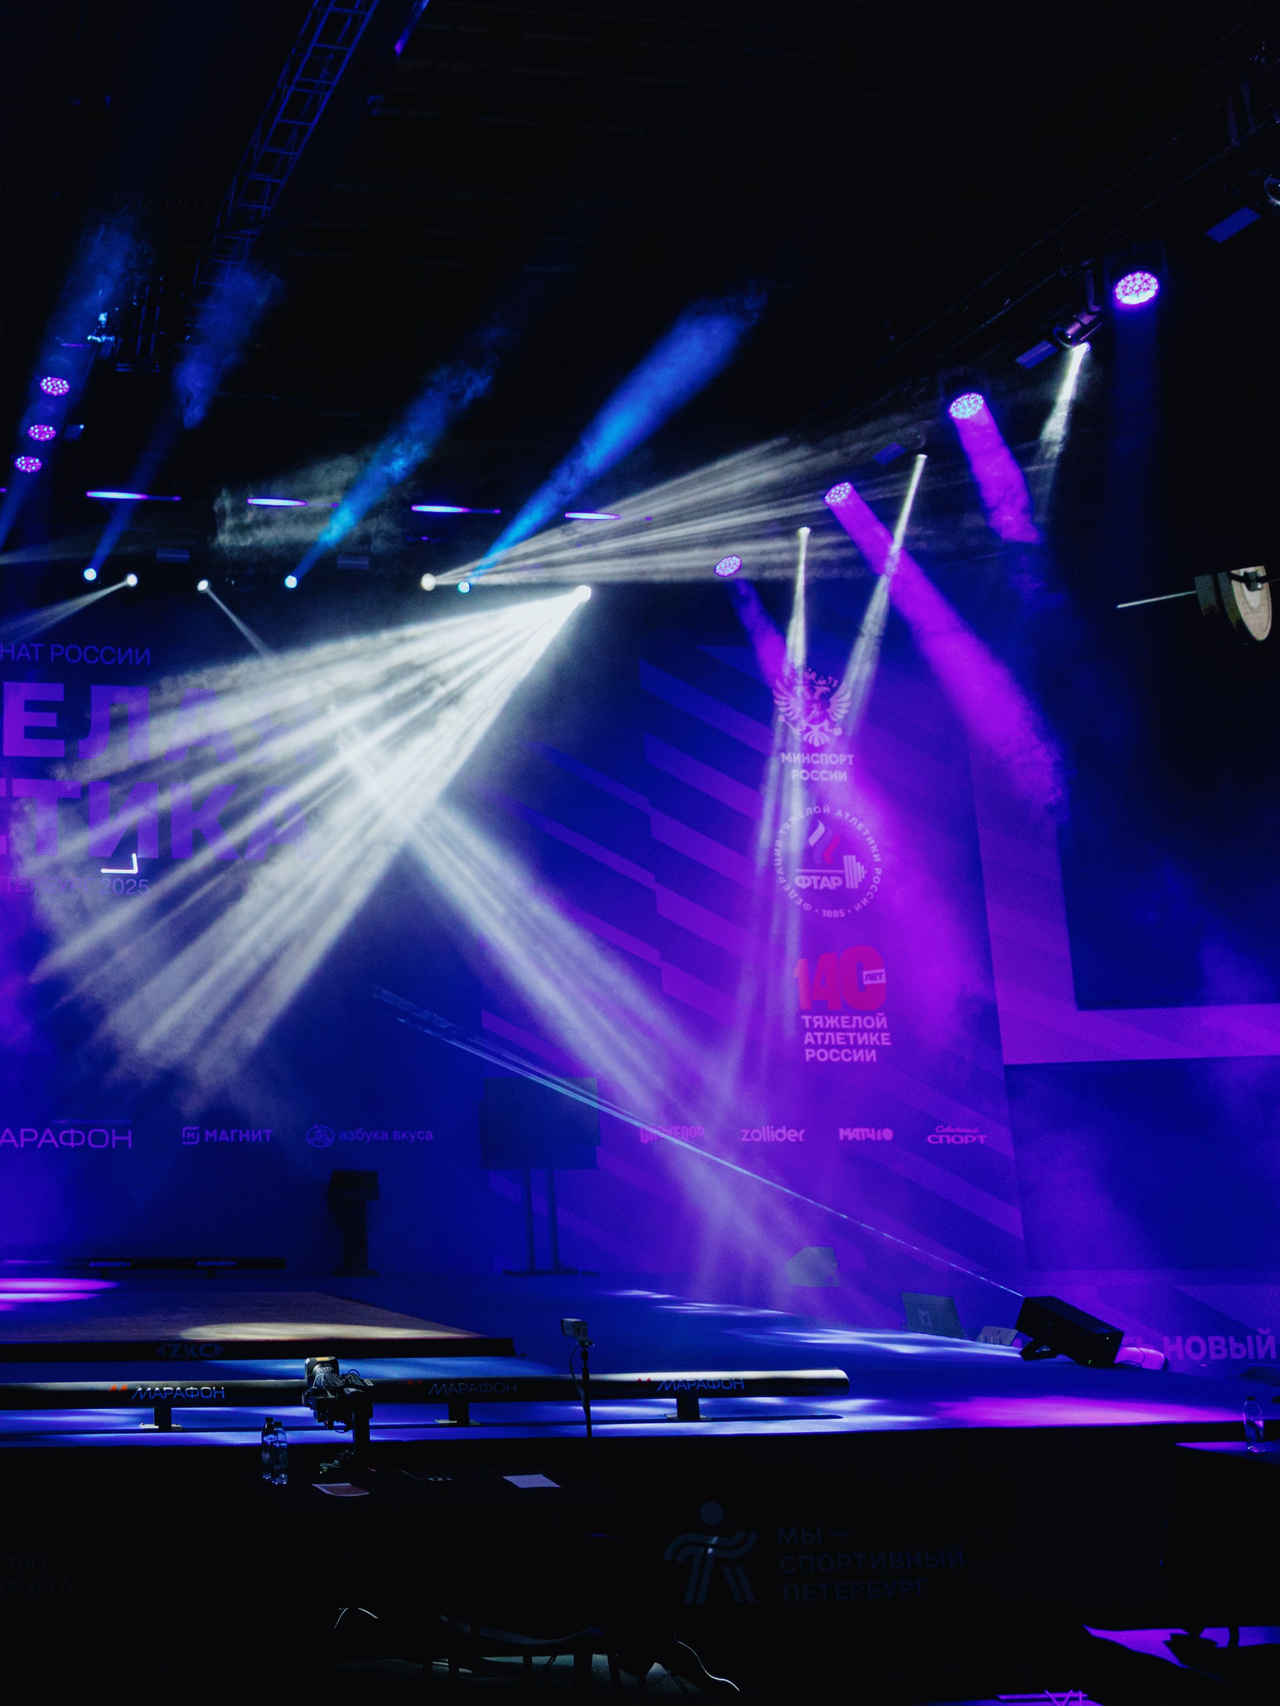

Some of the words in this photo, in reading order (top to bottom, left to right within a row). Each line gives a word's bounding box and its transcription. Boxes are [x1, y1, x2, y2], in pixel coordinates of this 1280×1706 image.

[50, 644, 151, 666] РОССИИ
[781, 752, 854, 765] МИНСПОРТ
[791, 769, 848, 782] РОССИИ
[100, 877, 150, 895] 2025
[794, 875, 843, 890] ФТАР
[822, 908, 846, 918] 1885
[801, 1012, 888, 1029] ТЯЖЕЛОЙ
[804, 1031, 892, 1045] АТЛЕТИКЕ
[805, 1048, 877, 1062] РОССИИ
[205, 1129, 273, 1142] МАГНИТ
[339, 1128, 389, 1143] азбука
[393, 1130, 434, 1143] вкуса
[740, 1125, 806, 1142] zollider
[927, 1134, 987, 1144] СПОРТ
[1162, 1327, 1277, 1361] НОВЫЙ
[131, 1387, 225, 1399] МАРАФОН
[428, 1382, 518, 1395] МАРАФОН
[657, 1378, 745, 1391] МАРАФОН
[777, 1526, 823, 1546] МЫ
[779, 1544, 966, 1574] СПОРТИВНЫЙ
[782, 1578, 929, 1603] ПЕТЕРБУРГ
